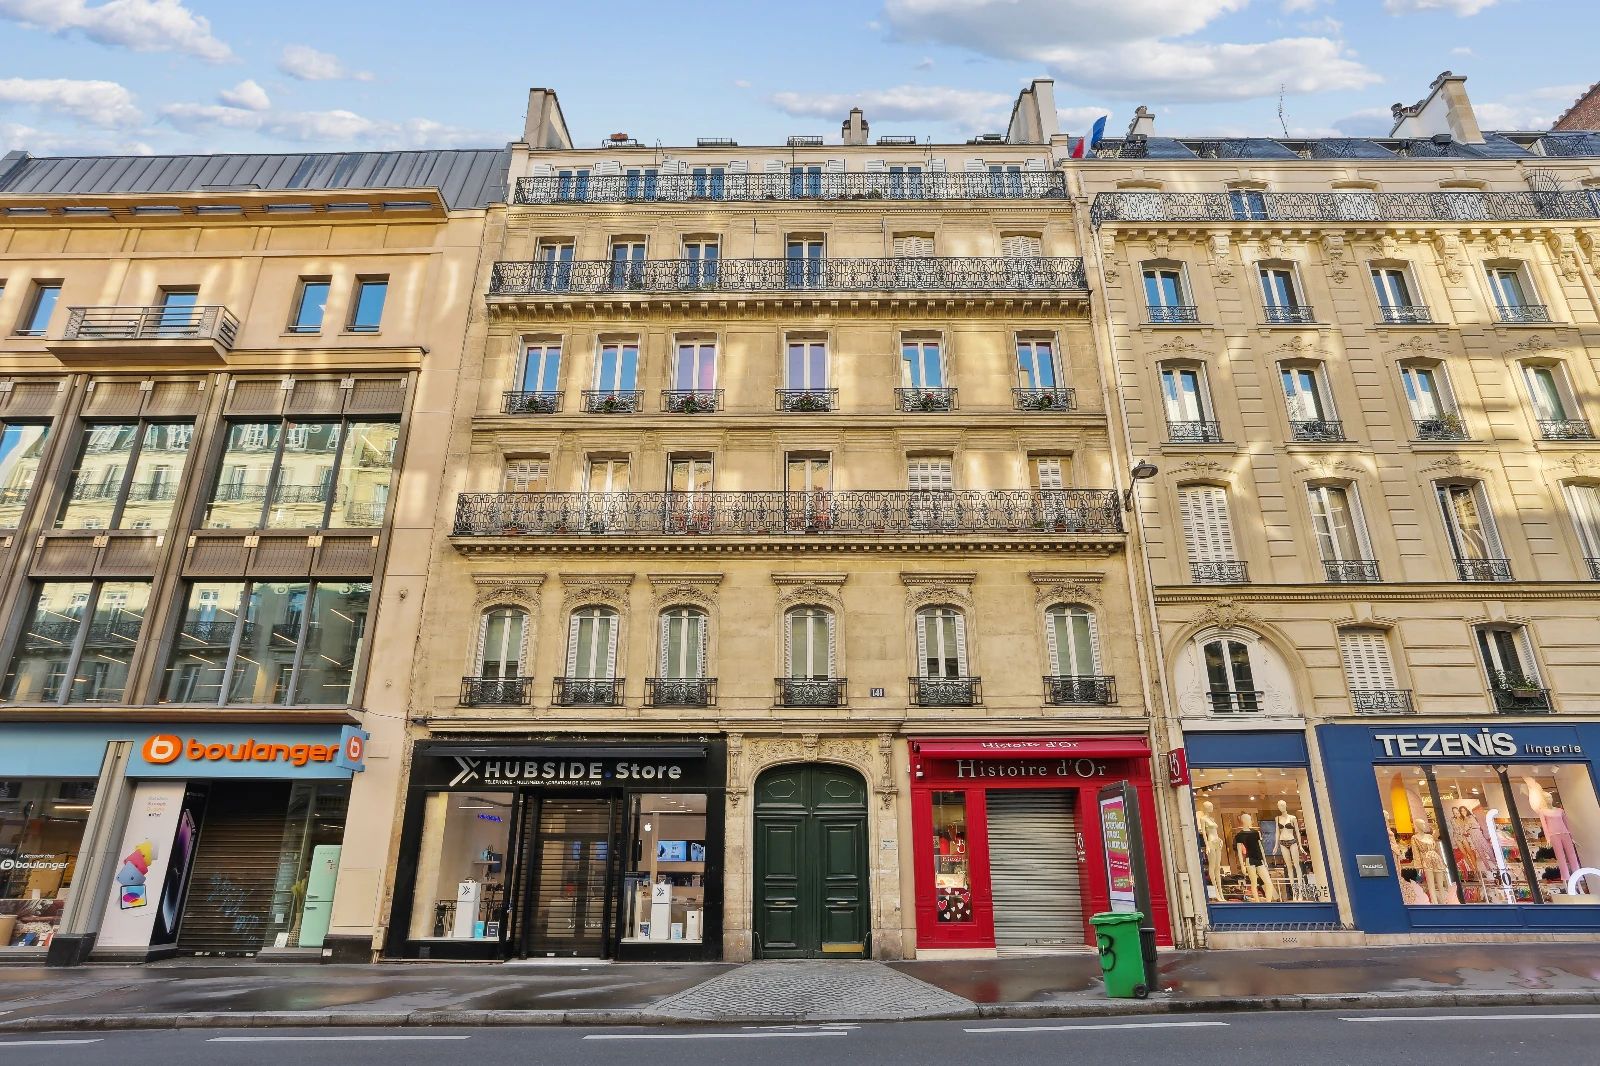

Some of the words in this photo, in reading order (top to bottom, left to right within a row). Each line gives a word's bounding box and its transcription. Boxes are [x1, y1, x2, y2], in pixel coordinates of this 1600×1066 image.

[872, 688, 883, 697] 141
[186, 738, 340, 767] boulanger
[1525, 743, 1582, 756] lingerie
[956, 759, 1048, 778] Histoire
[1056, 758, 1107, 778] d'Or
[15, 860, 70, 870] boulanger
